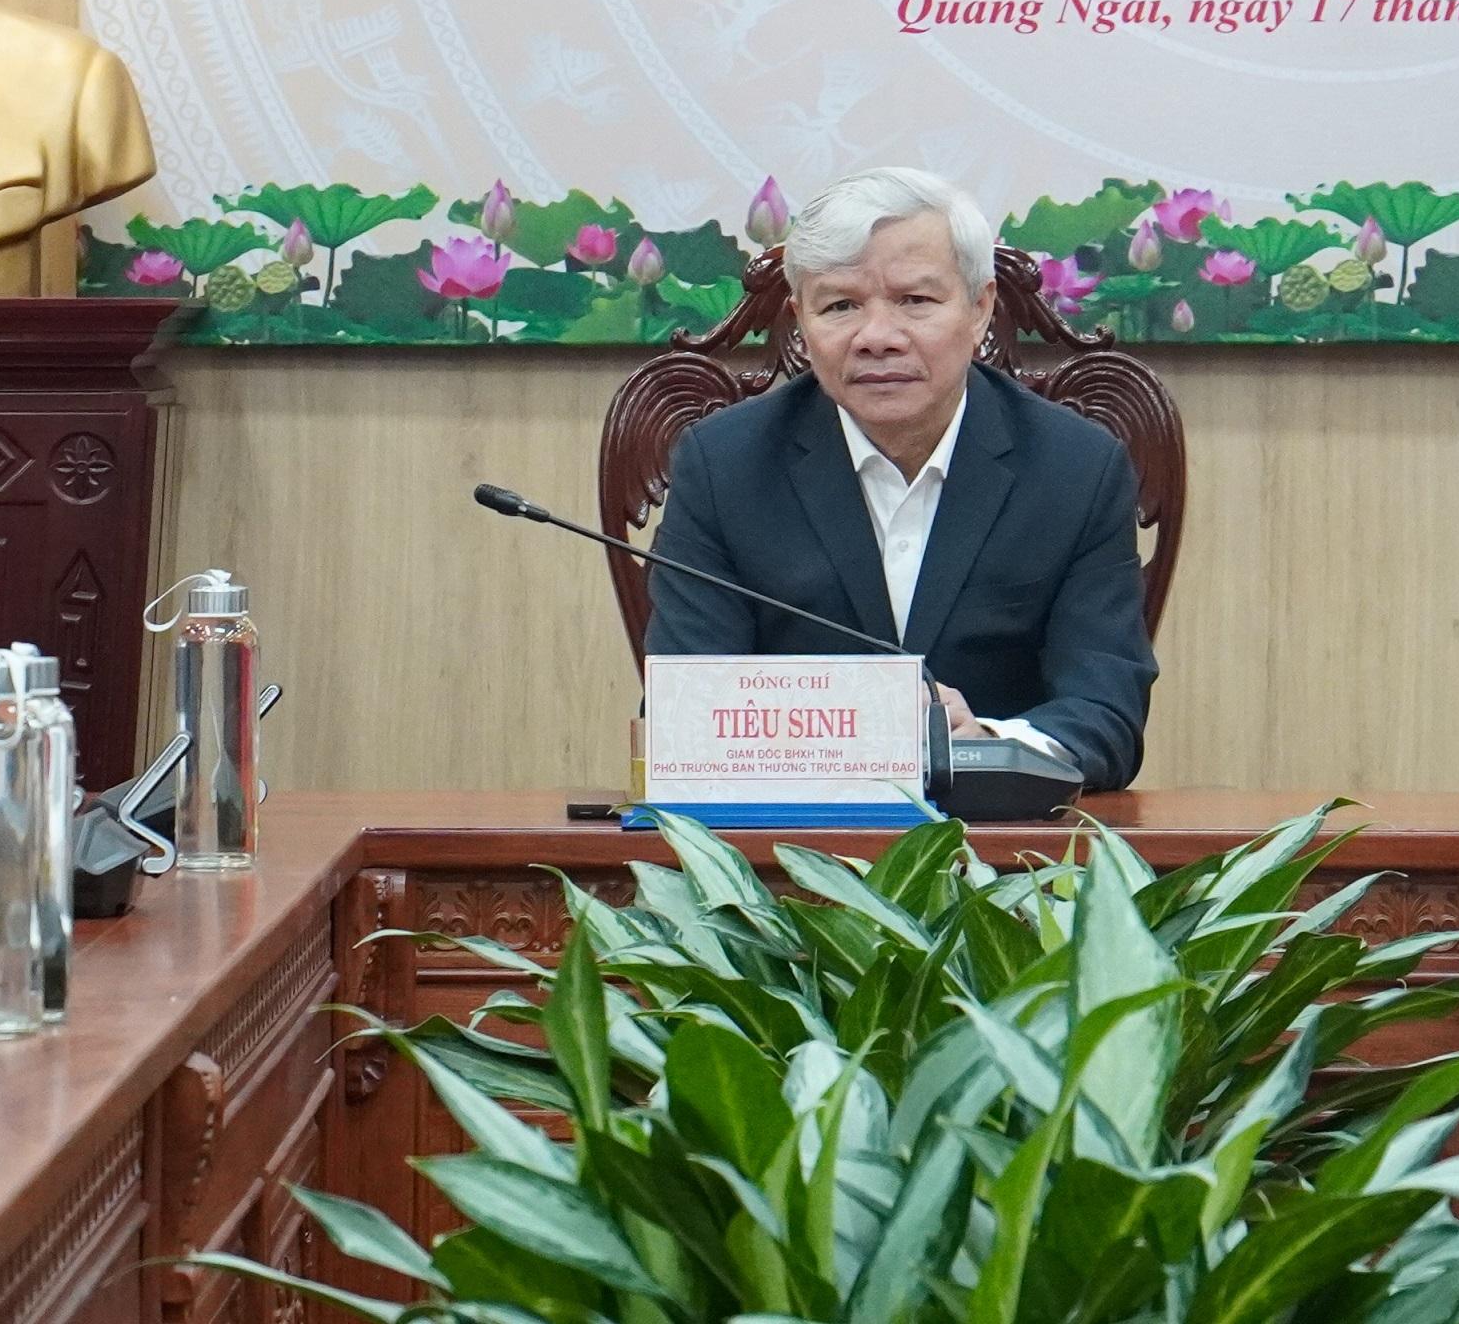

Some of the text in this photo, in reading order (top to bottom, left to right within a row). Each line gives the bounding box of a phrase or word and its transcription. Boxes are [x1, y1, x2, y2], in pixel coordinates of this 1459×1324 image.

[797, 672, 830, 690] CHÍ
[712, 699, 857, 739] TIÊU SINH
[784, 748, 815, 759] BHXH
[732, 763, 755, 773] BAN
[844, 763, 867, 773] BAN
